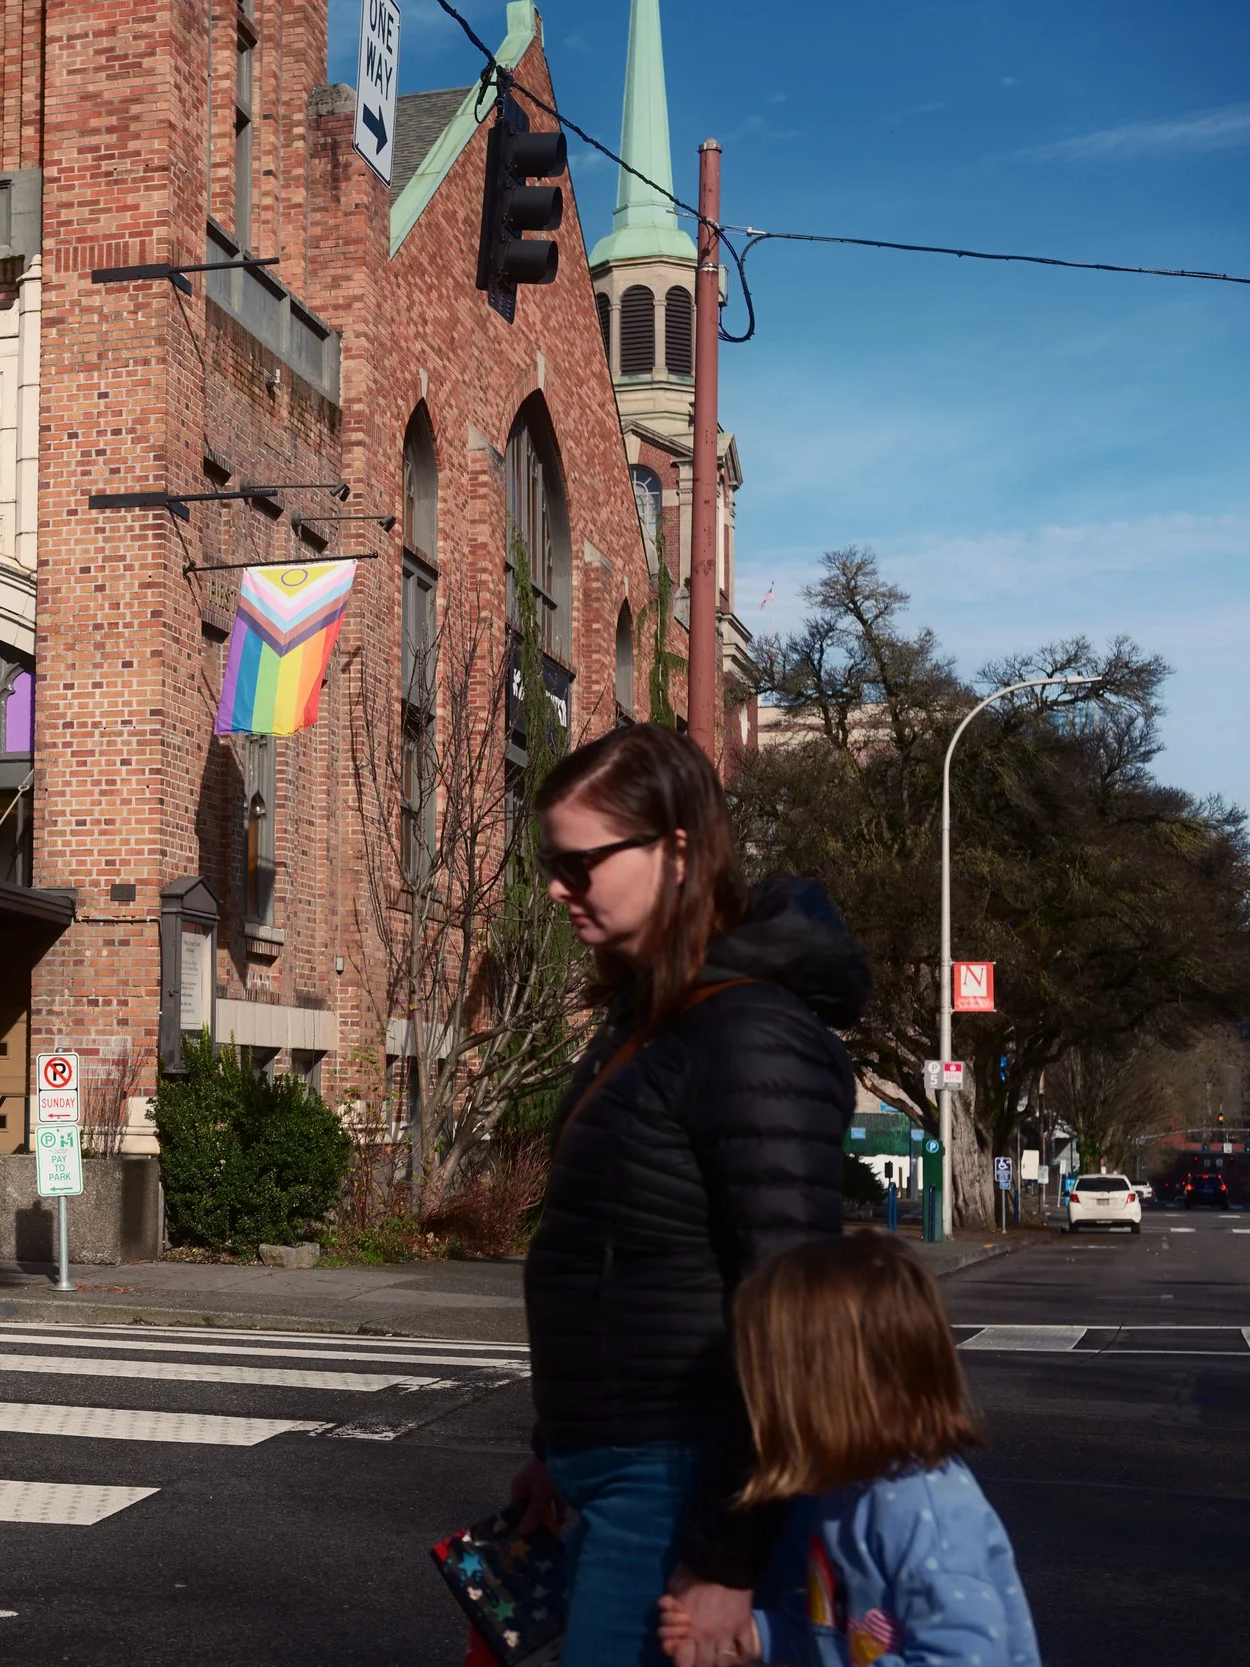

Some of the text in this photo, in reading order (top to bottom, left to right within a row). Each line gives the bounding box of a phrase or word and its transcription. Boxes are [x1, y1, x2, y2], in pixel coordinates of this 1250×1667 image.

[369, 0, 394, 55] ONE
[366, 36, 393, 101] WAY
[930, 1074, 938, 1085] 5
[41, 1097, 76, 1109] SUNDAY
[51, 1155, 67, 1164] PAY
[54, 1164, 66, 1172] TO
[49, 1173, 72, 1181] PARK
